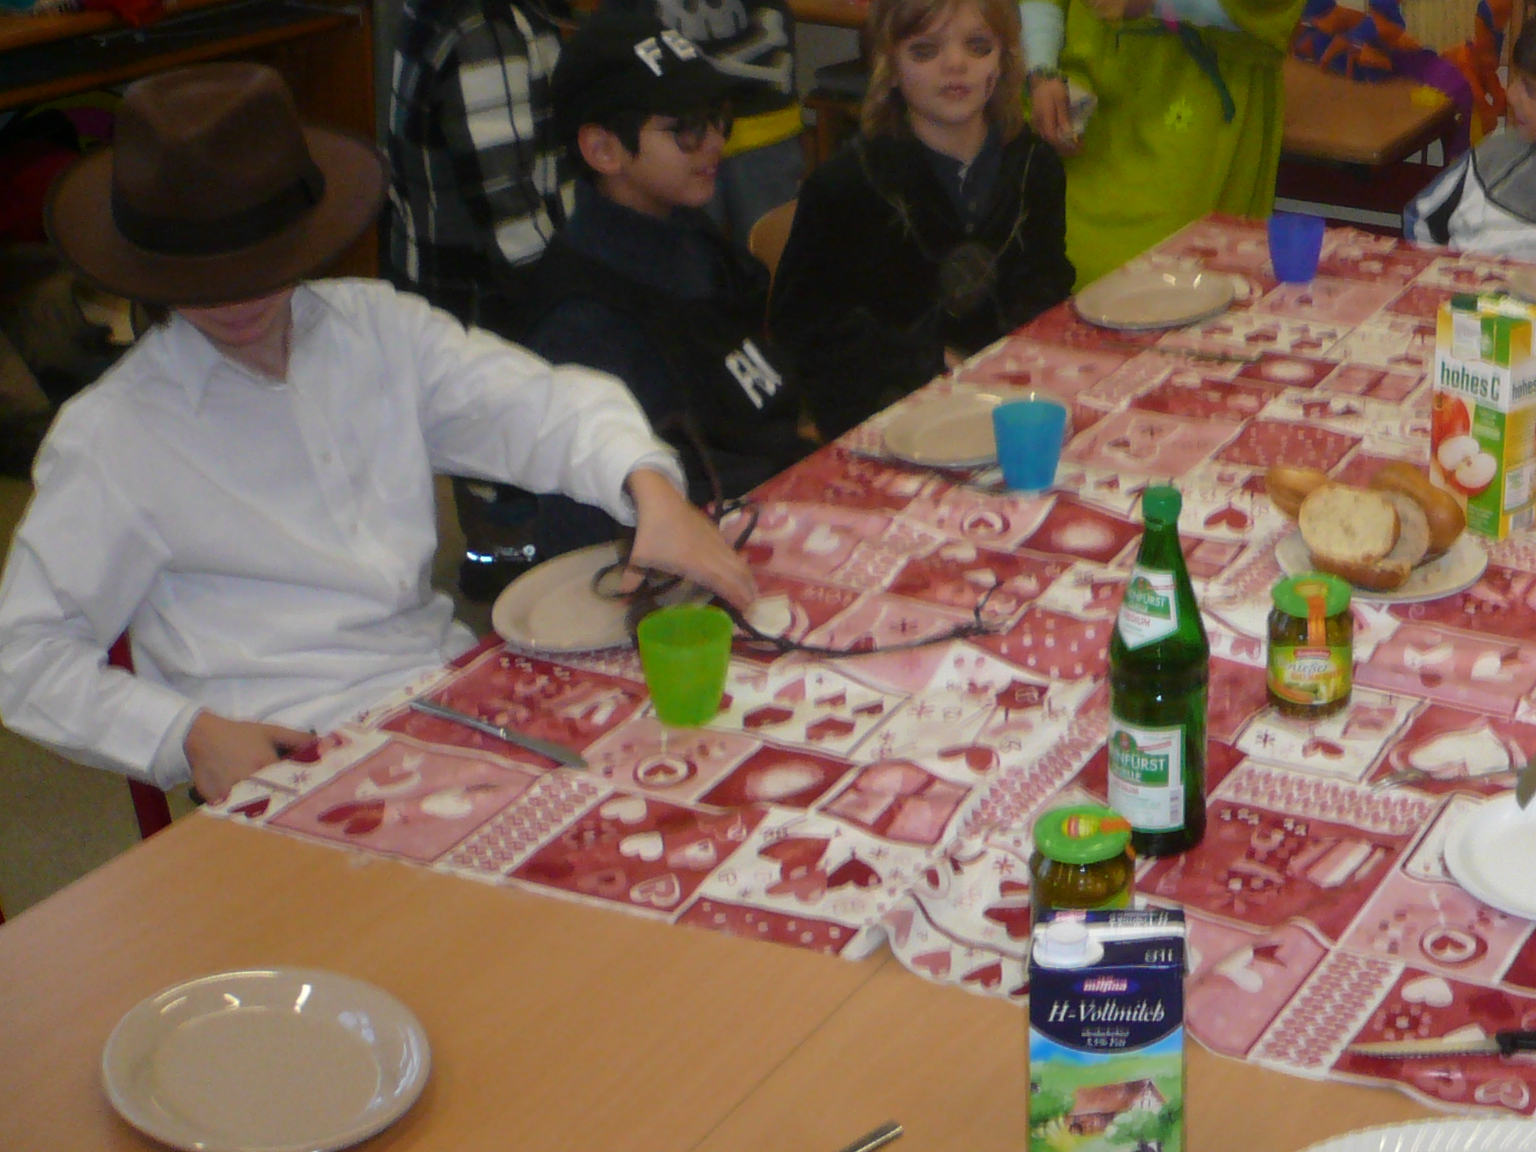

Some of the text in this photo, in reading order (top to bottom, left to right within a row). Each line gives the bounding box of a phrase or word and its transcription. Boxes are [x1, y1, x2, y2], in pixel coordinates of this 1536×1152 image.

[1440, 360, 1501, 402] hohes C
[1082, 977, 1128, 993] milfina
[1047, 999, 1166, 1023] H-Vollmilch
